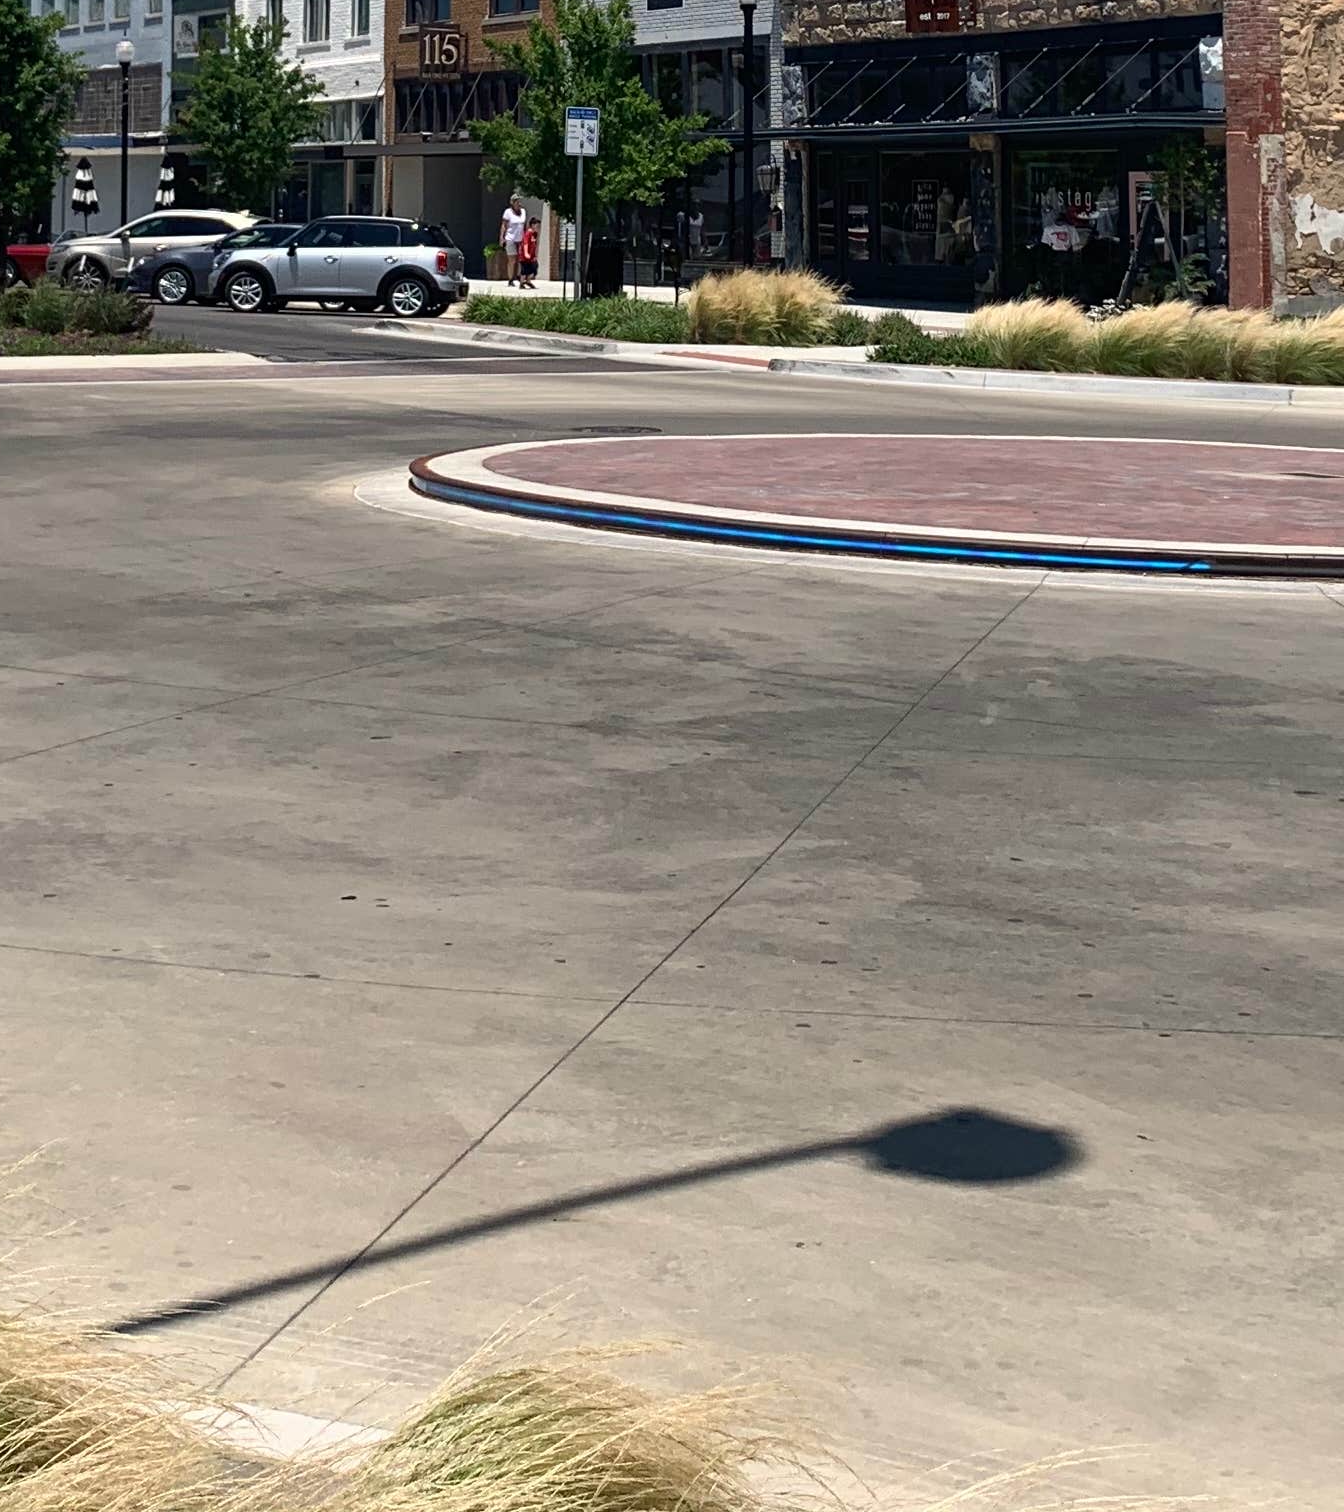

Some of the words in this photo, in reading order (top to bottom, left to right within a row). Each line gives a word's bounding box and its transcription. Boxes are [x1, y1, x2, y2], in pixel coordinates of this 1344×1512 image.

[936, 12, 950, 20] 2017
[423, 33, 459, 65] 115
[1057, 187, 1092, 211] stag
